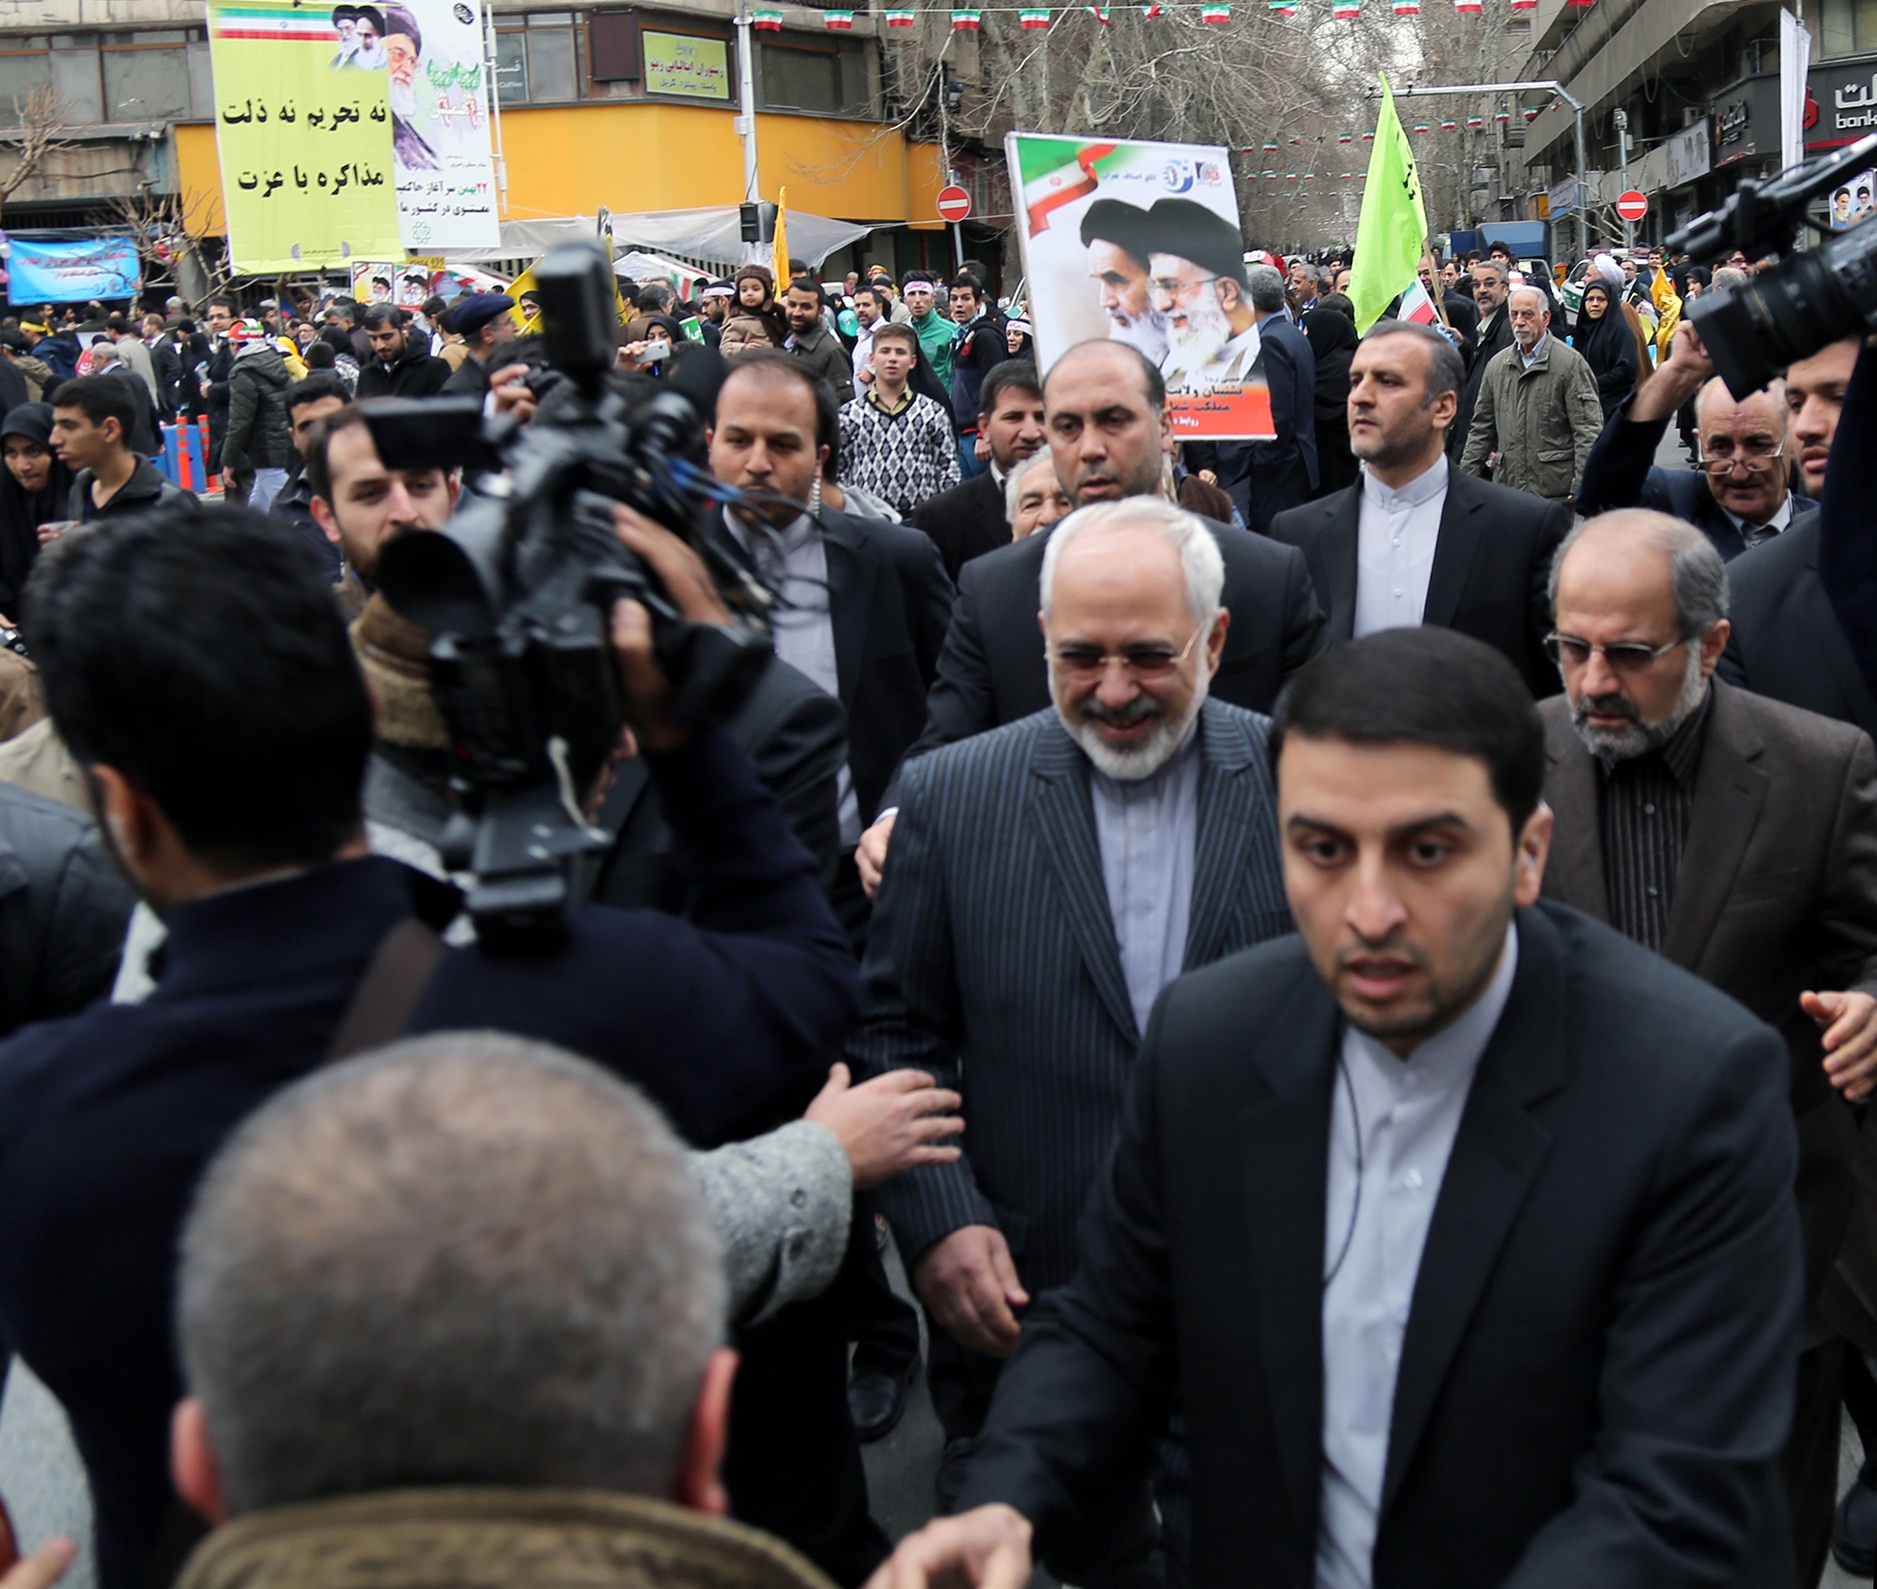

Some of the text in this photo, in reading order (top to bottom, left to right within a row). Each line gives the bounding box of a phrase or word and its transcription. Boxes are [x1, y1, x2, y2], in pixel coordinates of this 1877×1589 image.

[695, 63, 724, 78] رستوران
[1835, 73, 1877, 109] لت
[222, 98, 387, 131] نه تحریم نه ذلت
[237, 162, 384, 198] مذاکره با عزت
[395, 181, 423, 195] حاکمی
